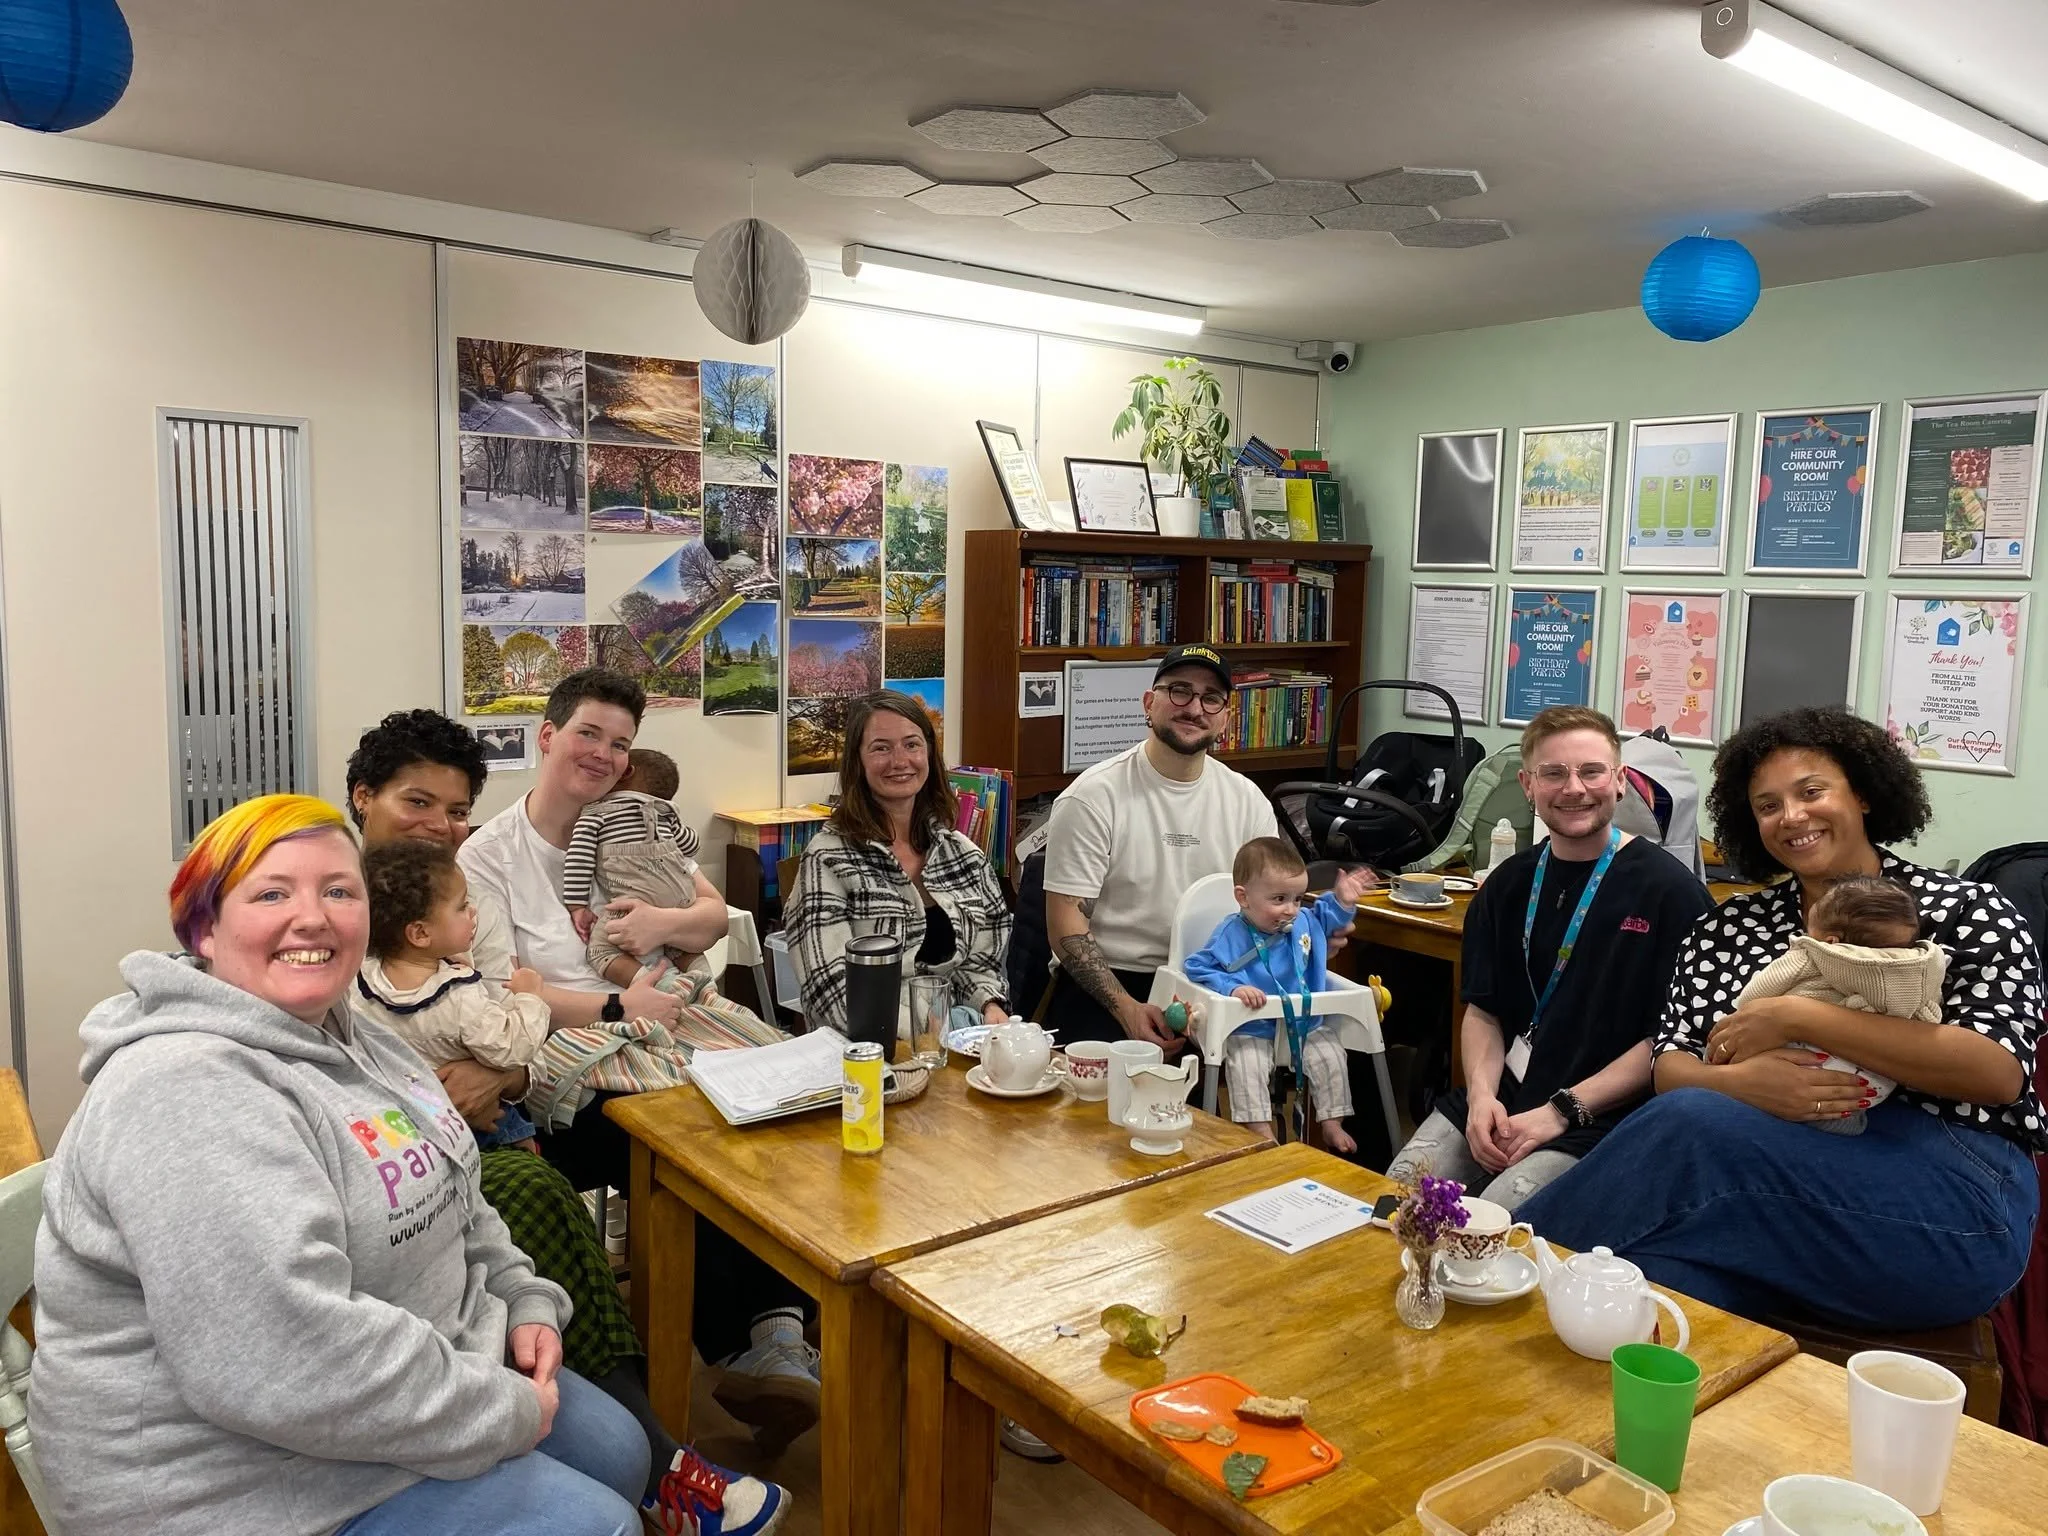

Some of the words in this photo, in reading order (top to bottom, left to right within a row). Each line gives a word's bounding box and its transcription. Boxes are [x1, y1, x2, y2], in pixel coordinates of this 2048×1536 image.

[1790, 450, 1812, 460] HIRE
[1814, 450, 1837, 458] OUR
[1781, 460, 1845, 470] COMMUNITY
[1794, 472, 1829, 481] ROOM!
[1783, 490, 1837, 501] BIRTHDAY
[1786, 502, 1832, 512] PARTIES
[1533, 624, 1550, 632] HIRE
[1552, 624, 1569, 632] OUR
[1527, 633, 1576, 642] COMMUNITY
[1536, 642, 1564, 651] ROOM!
[1528, 657, 1570, 669] BIRTHDAY
[1928, 650, 1958, 665] Thank
[1960, 656, 1985, 669] You!
[1531, 667, 1566, 678] PARTIES
[1961, 739, 2002, 749] Community
[1318, 1192, 1350, 1207] DRINKS
[388, 1213, 403, 1223] Run
[406, 1207, 414, 1215] by
[416, 1198, 425, 1209] and
